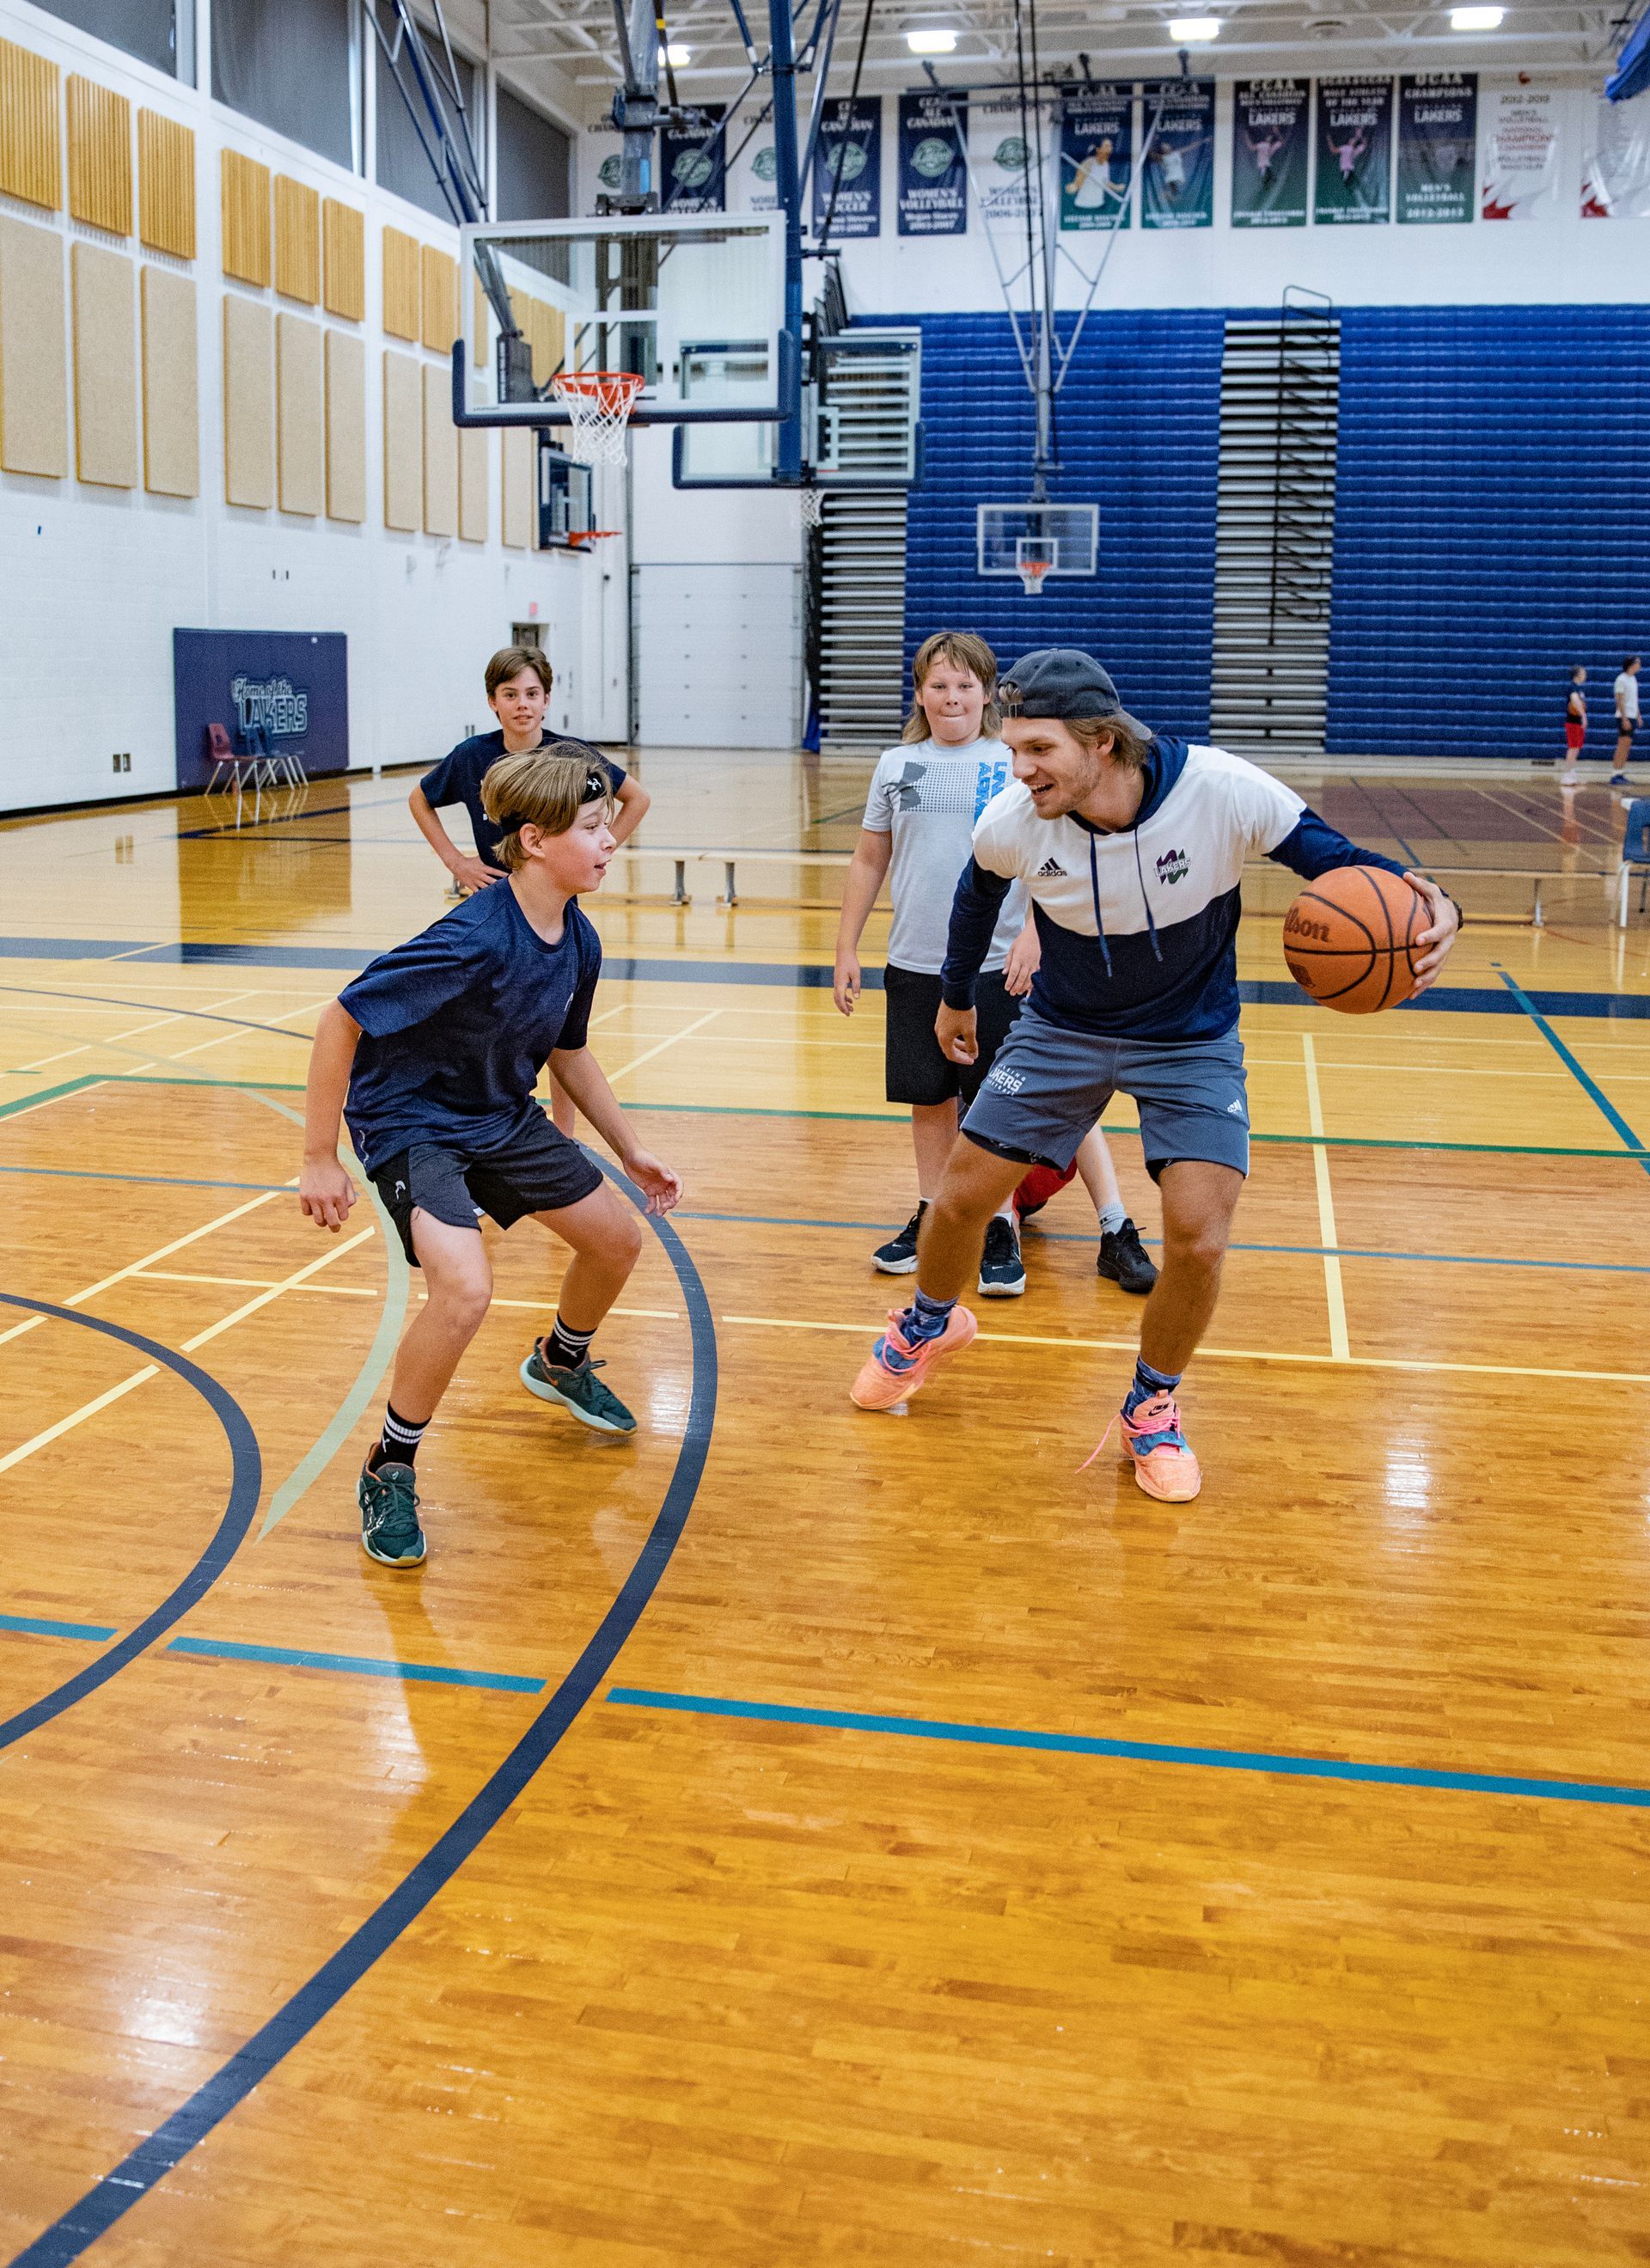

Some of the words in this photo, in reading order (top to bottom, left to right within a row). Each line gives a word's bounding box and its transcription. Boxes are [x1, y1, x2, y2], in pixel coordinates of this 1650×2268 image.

[1404, 87, 1473, 99] CHAMPIONS
[1249, 113, 1296, 126] LAKERS
[1330, 113, 1378, 126] LAKERS
[1415, 109, 1464, 123] LAKERS
[908, 187, 958, 199] WOMEN'S
[1405, 192, 1466, 203] VOLLEYBALL
[899, 199, 963, 210] VOLLEYBALL
[240, 694, 308, 734] LAKERS
[1037, 869, 1068, 877] adidas
[1154, 858, 1192, 877] LAKERS
